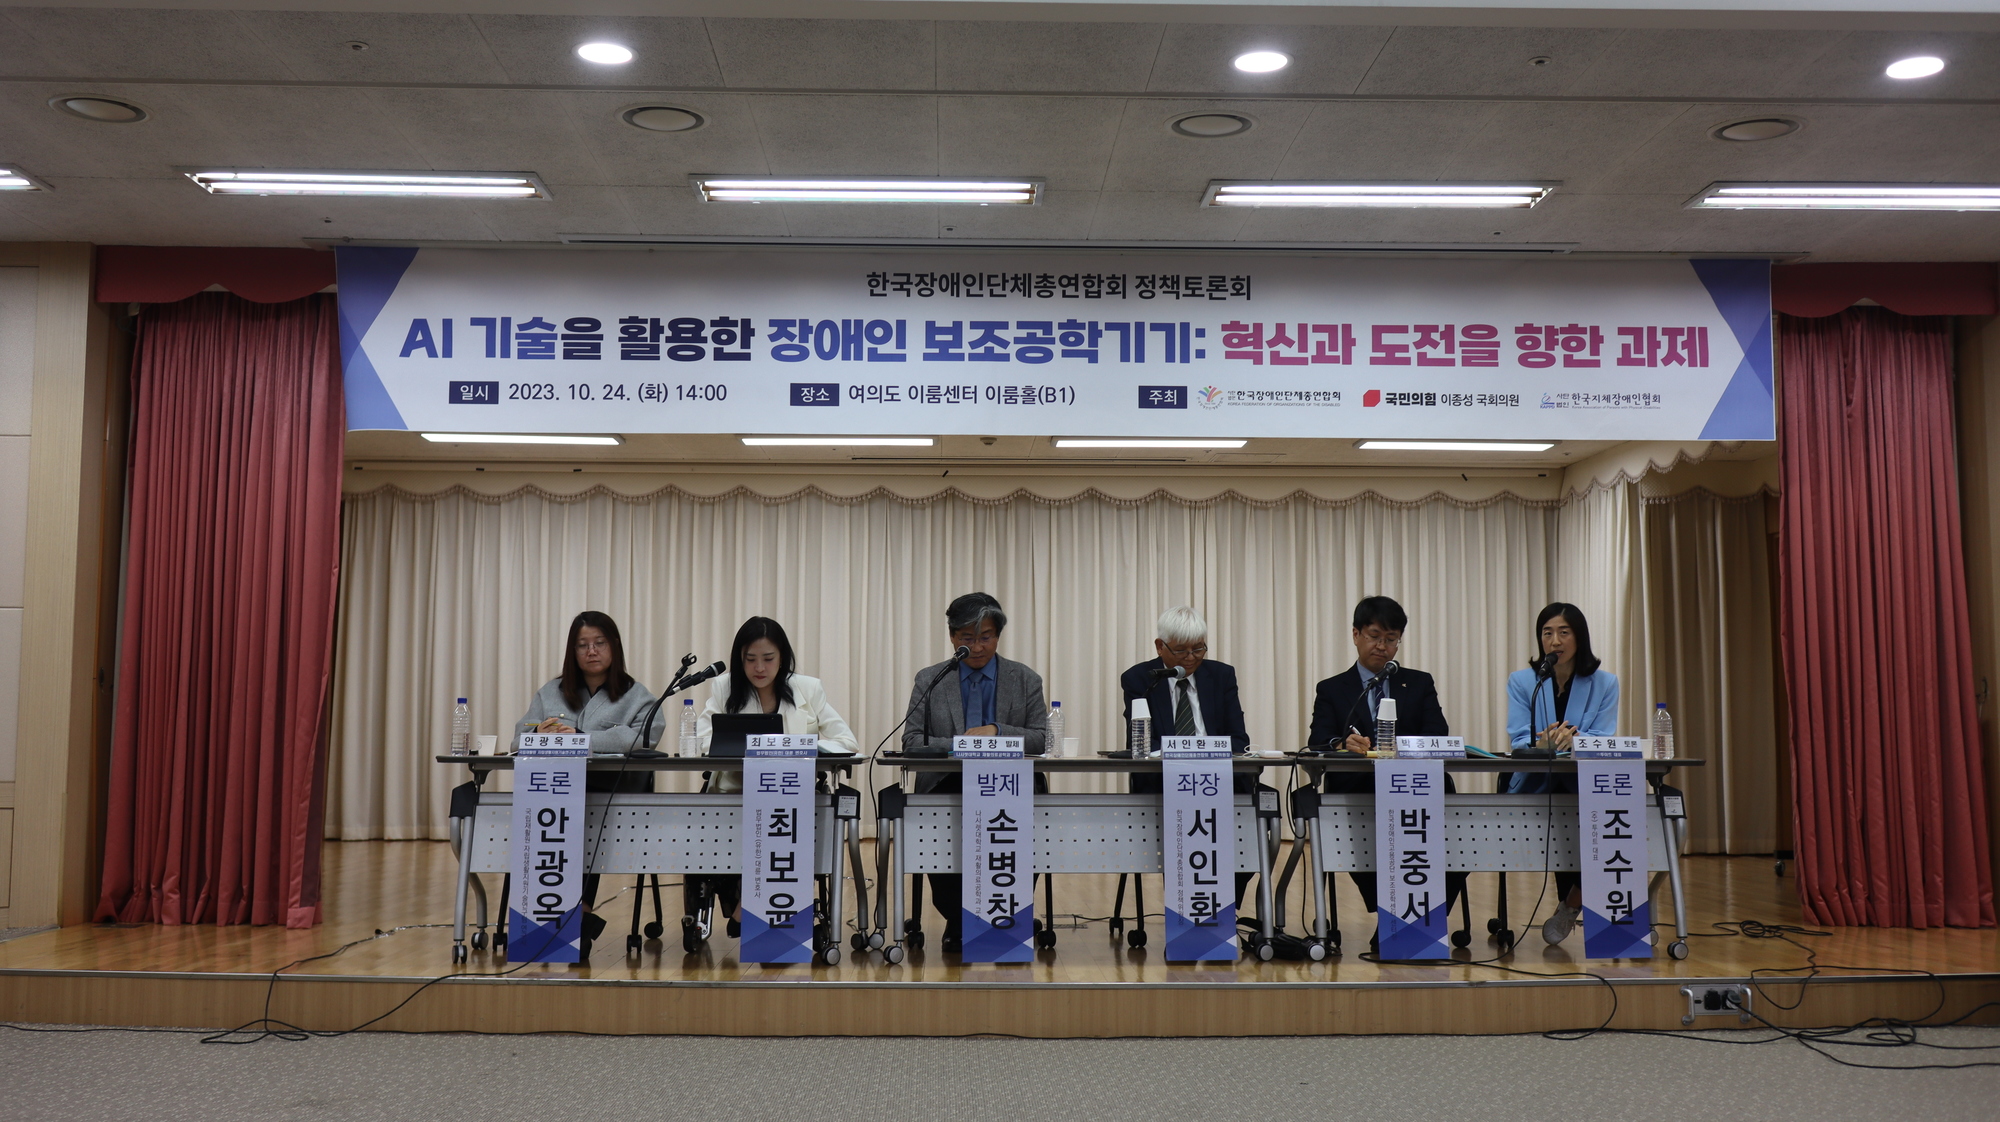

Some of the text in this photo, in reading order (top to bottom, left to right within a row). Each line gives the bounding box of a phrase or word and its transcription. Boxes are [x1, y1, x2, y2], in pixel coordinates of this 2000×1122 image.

[866, 272, 1252, 300] 한국장애인단체총연합회 정책토론회
[399, 316, 1710, 368] AI 기술을 활용한 장애인 보조공학기기: 혁신과 도전을 향한 과제
[460, 384, 489, 401] 일시
[508, 382, 727, 403] 2023. 10. 24. (화) 14:00
[800, 387, 830, 403] 장소
[848, 385, 1076, 406] 여의도 이룸센터 이룸홀(B1)
[1149, 389, 1178, 406] 주최
[1237, 390, 1341, 402] 한국장애인단체총연합회
[1385, 392, 1520, 408] 국민의힘 이종성 국회의원
[1571, 392, 1661, 406] 한국지체장애인협회
[571, 737, 586, 746] 토론
[799, 738, 814, 746] 토론
[1005, 740, 1020, 748] 발제
[1213, 740, 1228, 749] 좌장
[1446, 739, 1461, 748] 토론
[1623, 740, 1638, 749] 토론
[527, 772, 572, 794] 토론
[757, 772, 801, 794] 토론
[977, 773, 1019, 796] 발제
[1177, 773, 1220, 796] 좌장
[1389, 773, 1431, 796] 토론
[1592, 773, 1633, 796] 토론
[533, 807, 570, 929] 안광옥
[765, 808, 799, 929] 최보윤
[986, 809, 1019, 930] 손병창
[1187, 808, 1221, 927] 서인환
[1400, 808, 1431, 927] 박중서
[1602, 810, 1634, 925] 조수원
